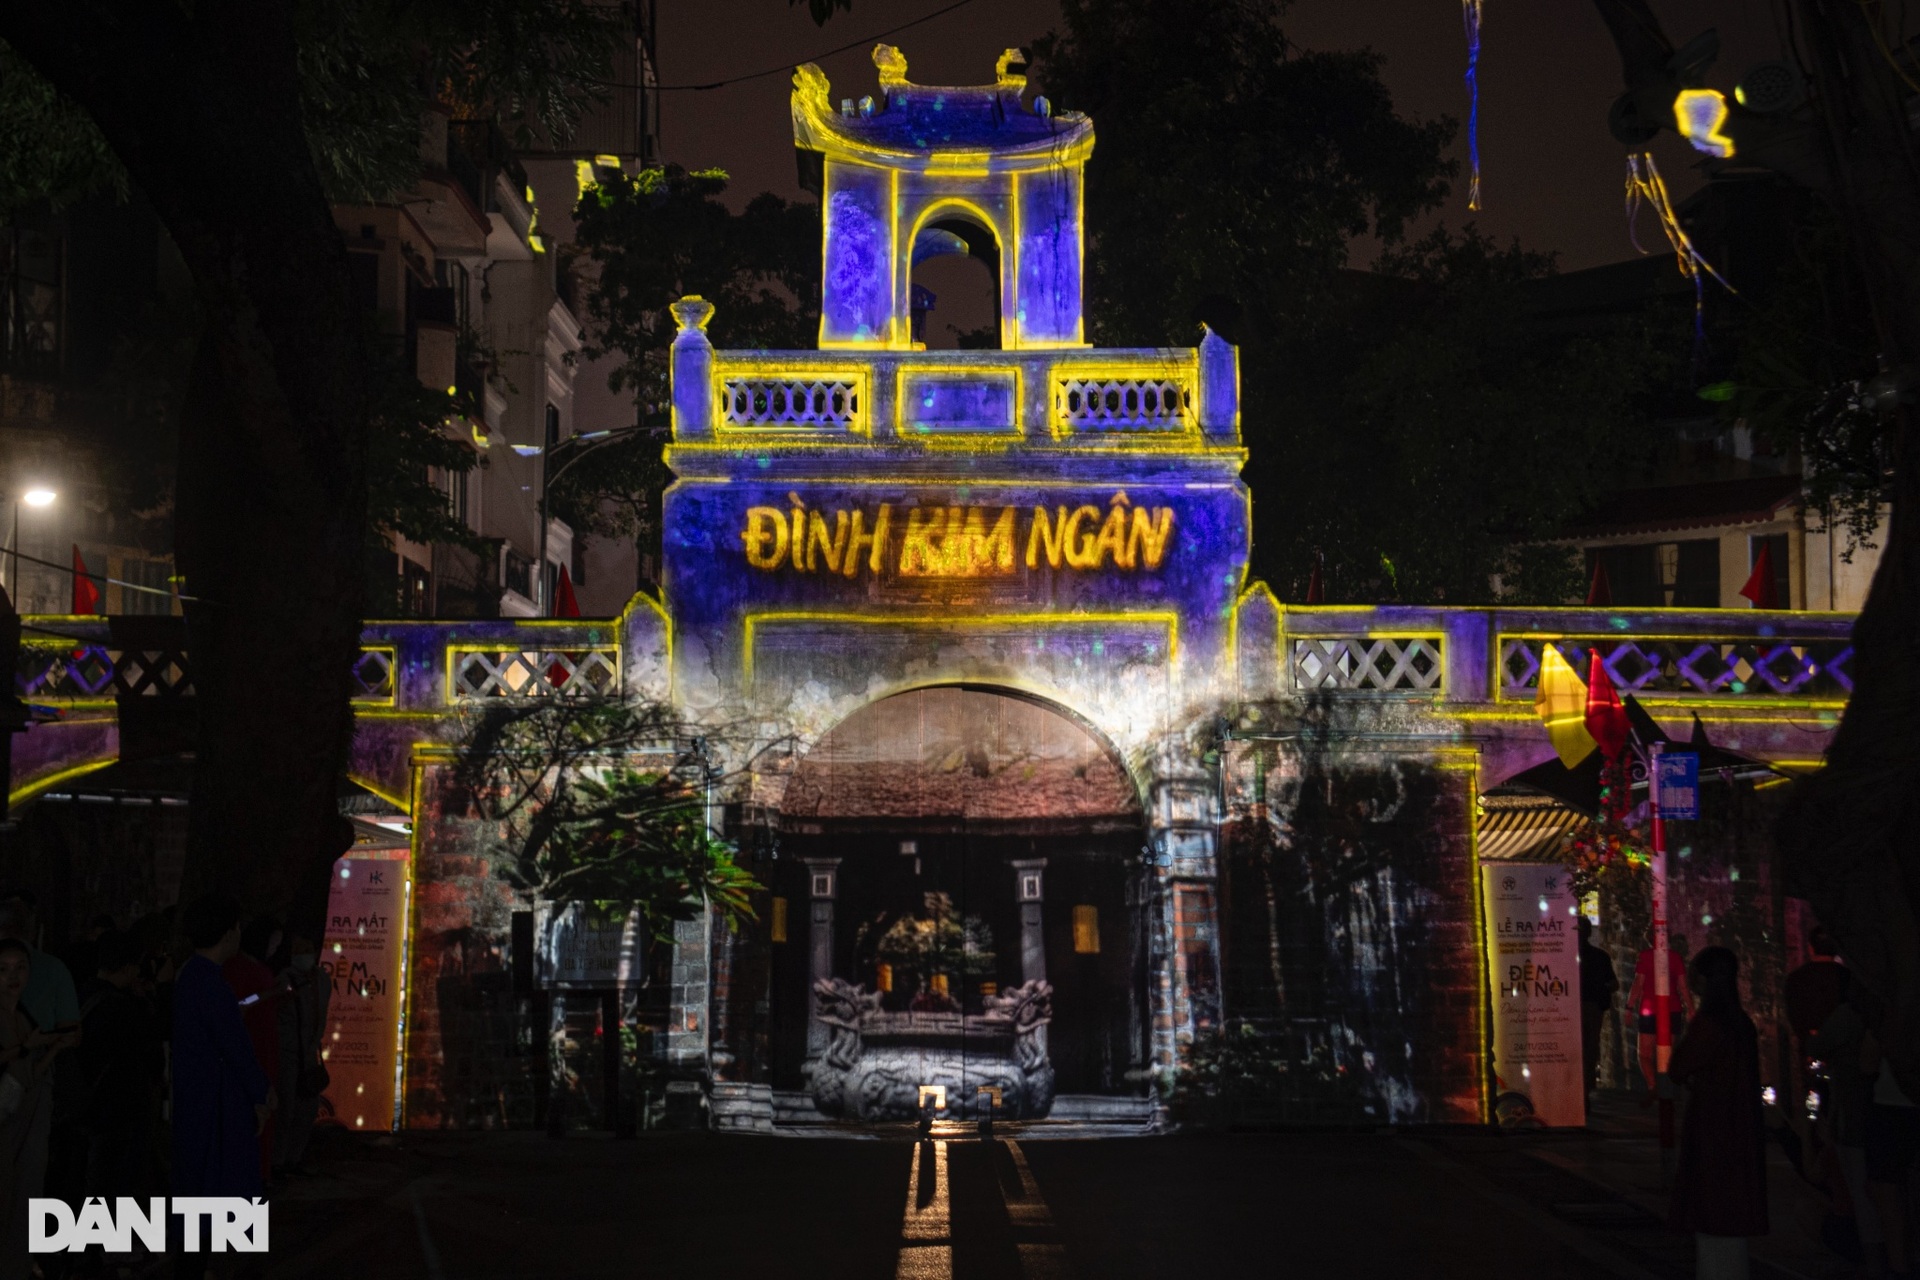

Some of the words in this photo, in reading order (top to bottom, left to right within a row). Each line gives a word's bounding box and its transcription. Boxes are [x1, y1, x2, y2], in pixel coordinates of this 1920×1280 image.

[742, 493, 891, 577] ĐÌNH
[900, 506, 1015, 576] KIM
[1026, 491, 1174, 570] NGÂN
[332, 916, 352, 928] RA
[1516, 921, 1534, 932] RA
[1537, 916, 1564, 932] MẮT
[1509, 959, 1551, 981] ĐÊM
[1535, 976, 1568, 1001] NỘI
